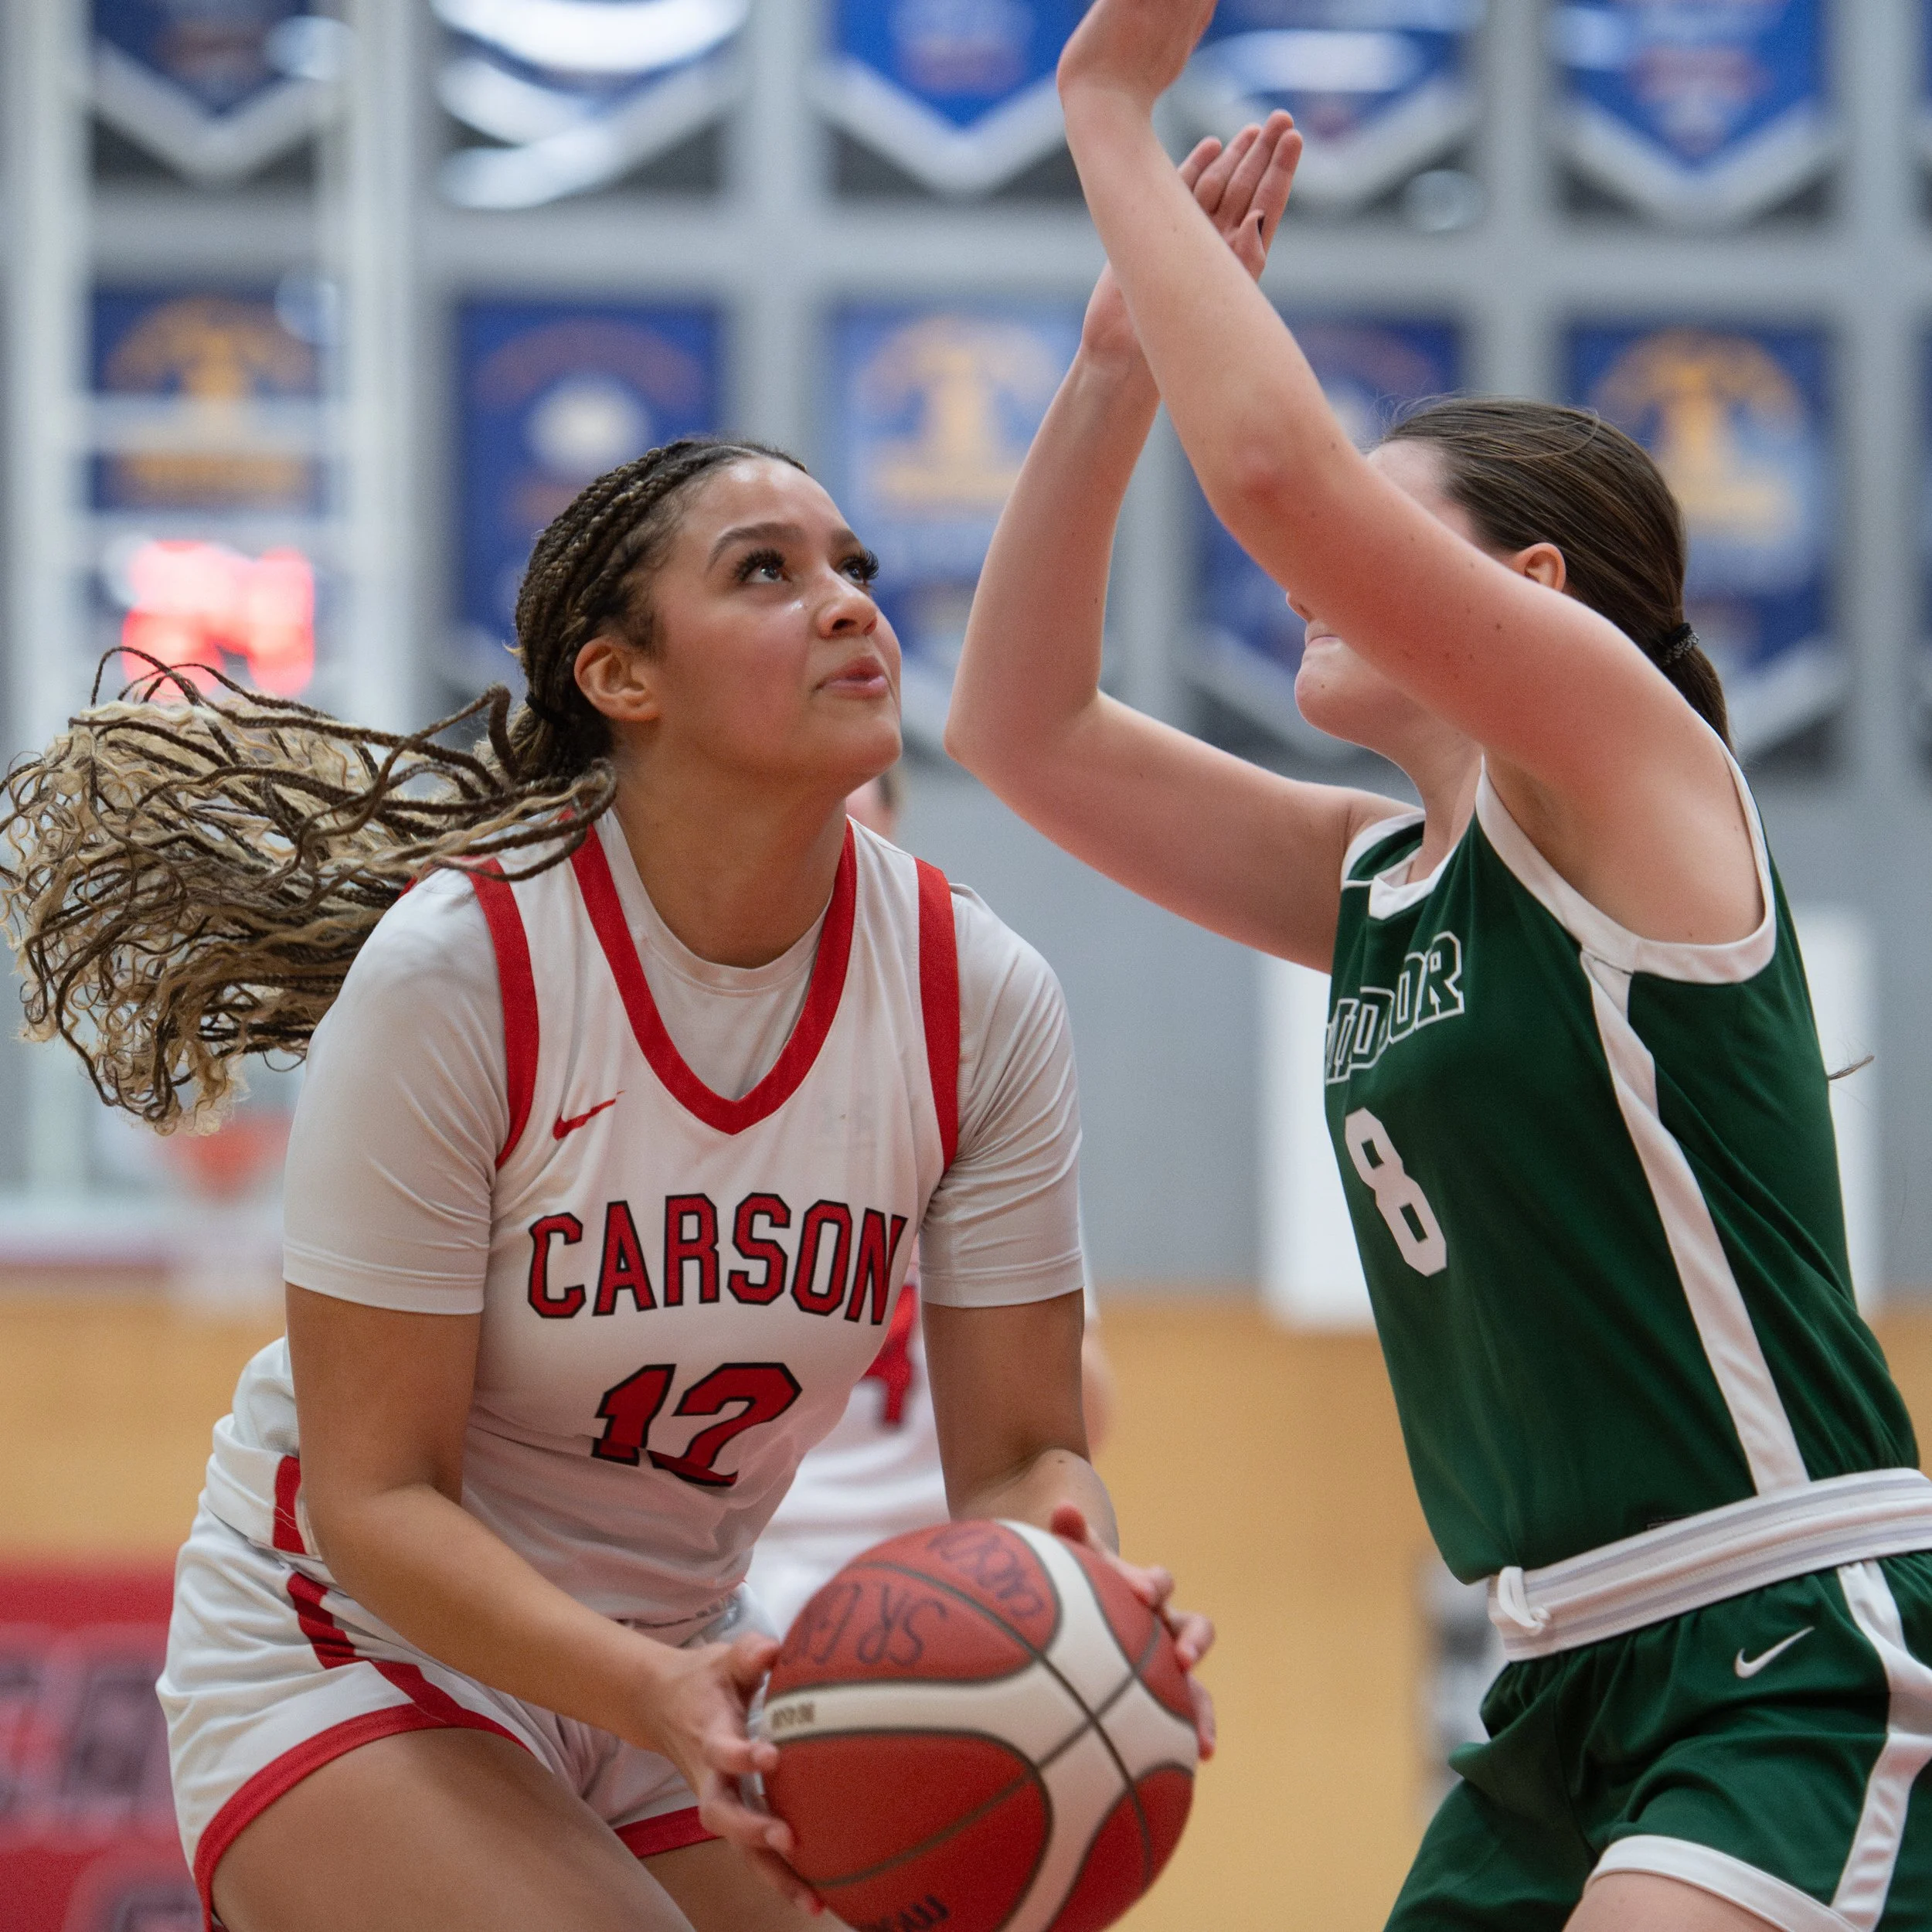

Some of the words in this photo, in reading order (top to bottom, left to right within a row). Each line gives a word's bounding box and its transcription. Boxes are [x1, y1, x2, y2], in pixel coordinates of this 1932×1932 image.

[528, 1192, 908, 1325] CARSON
[1345, 1107, 1447, 1277] 8
[590, 1362, 803, 1488] 12
